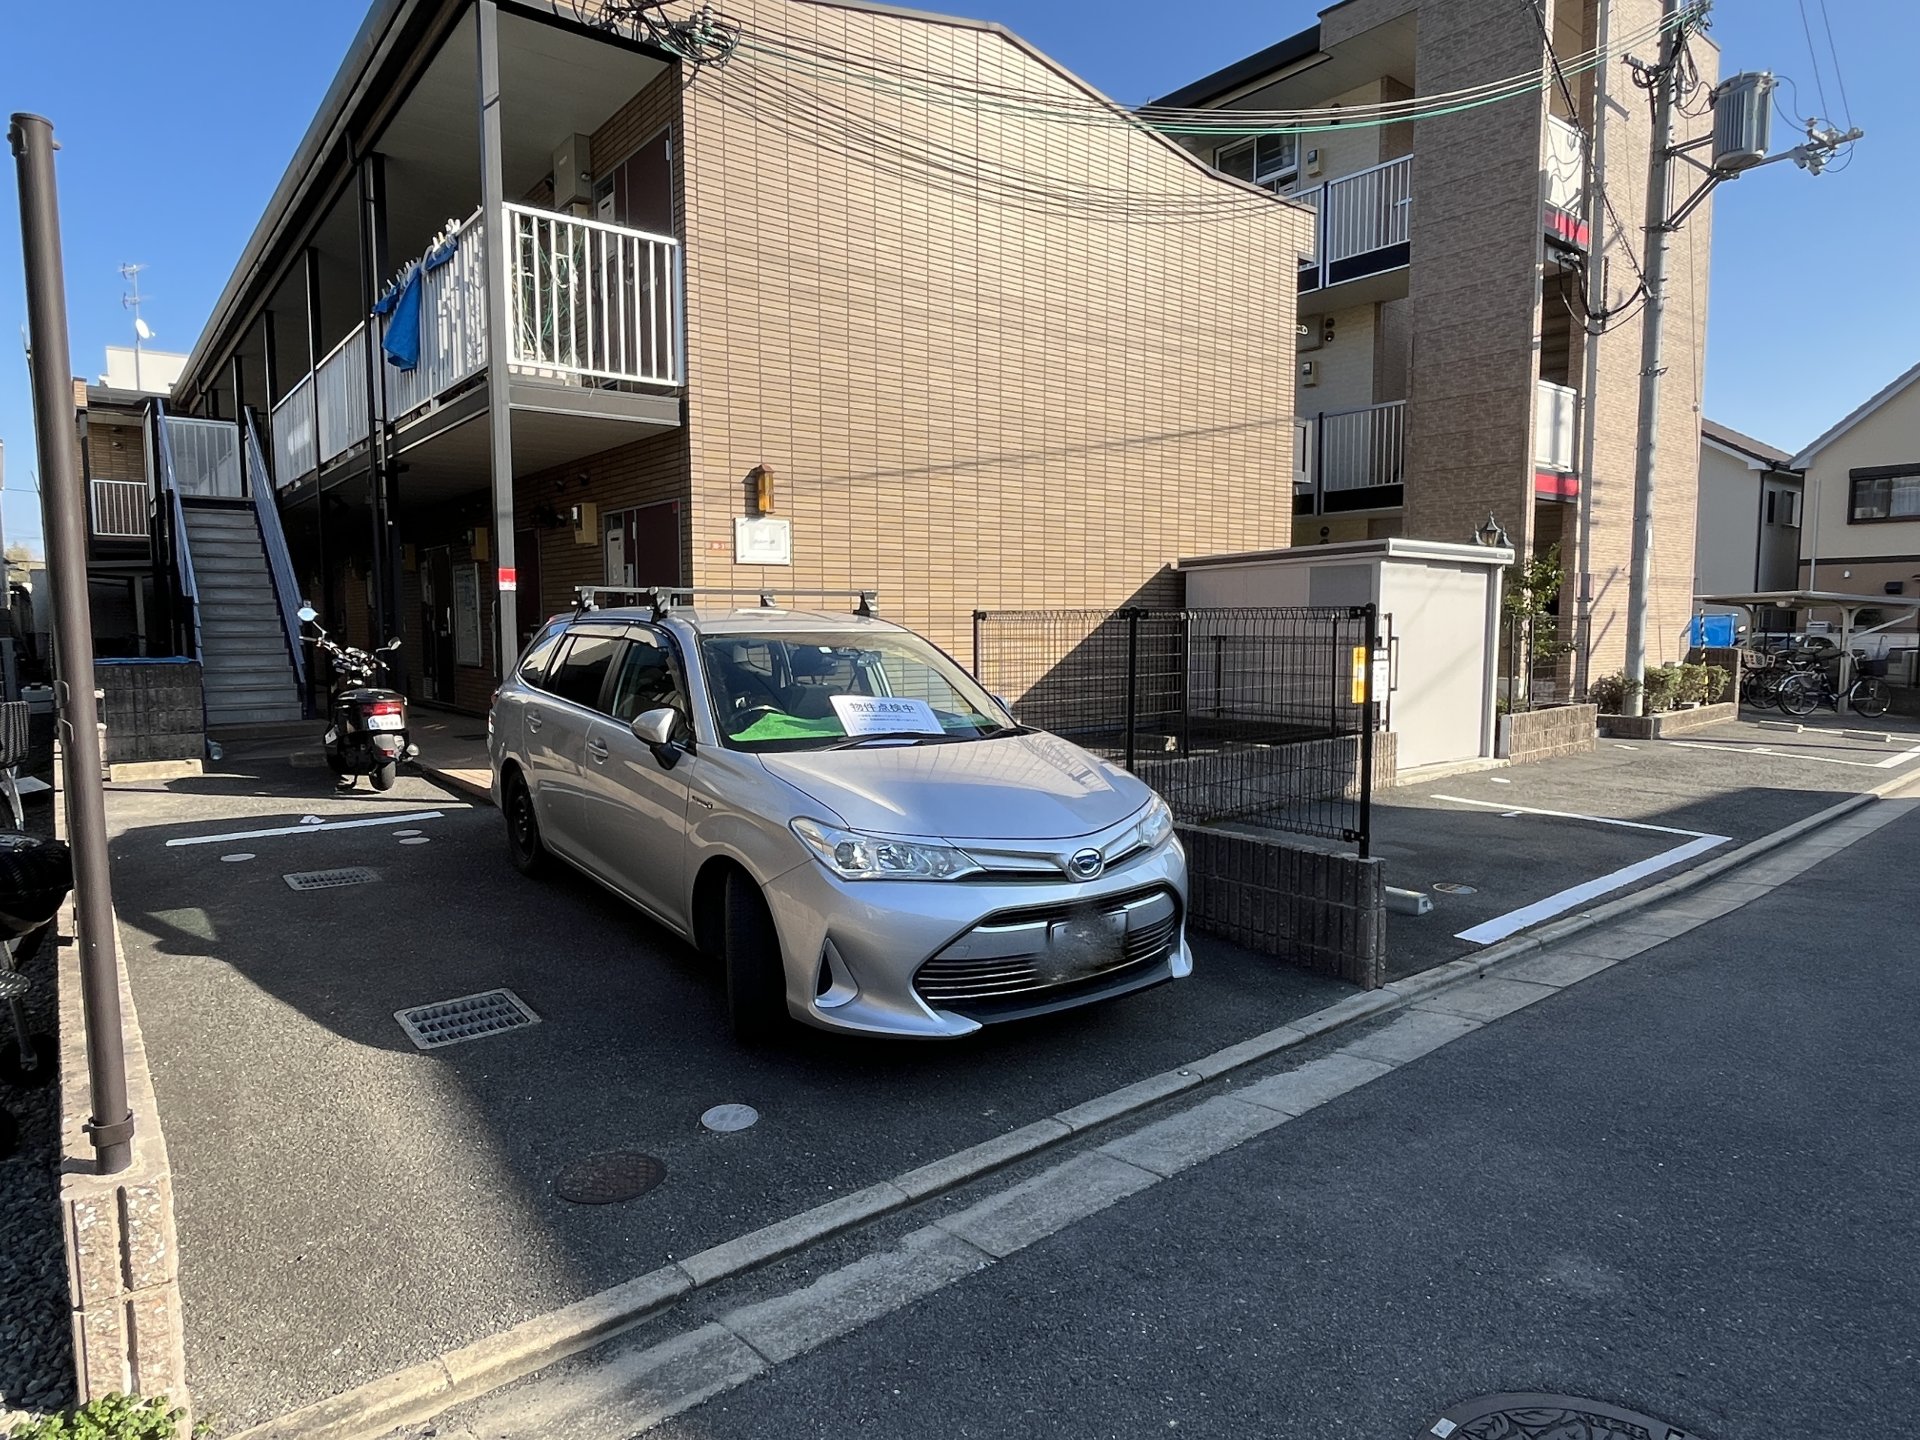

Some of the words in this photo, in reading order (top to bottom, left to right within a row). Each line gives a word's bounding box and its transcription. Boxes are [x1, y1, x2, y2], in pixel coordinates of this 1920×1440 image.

[850, 702, 914, 713] 物件点検中
